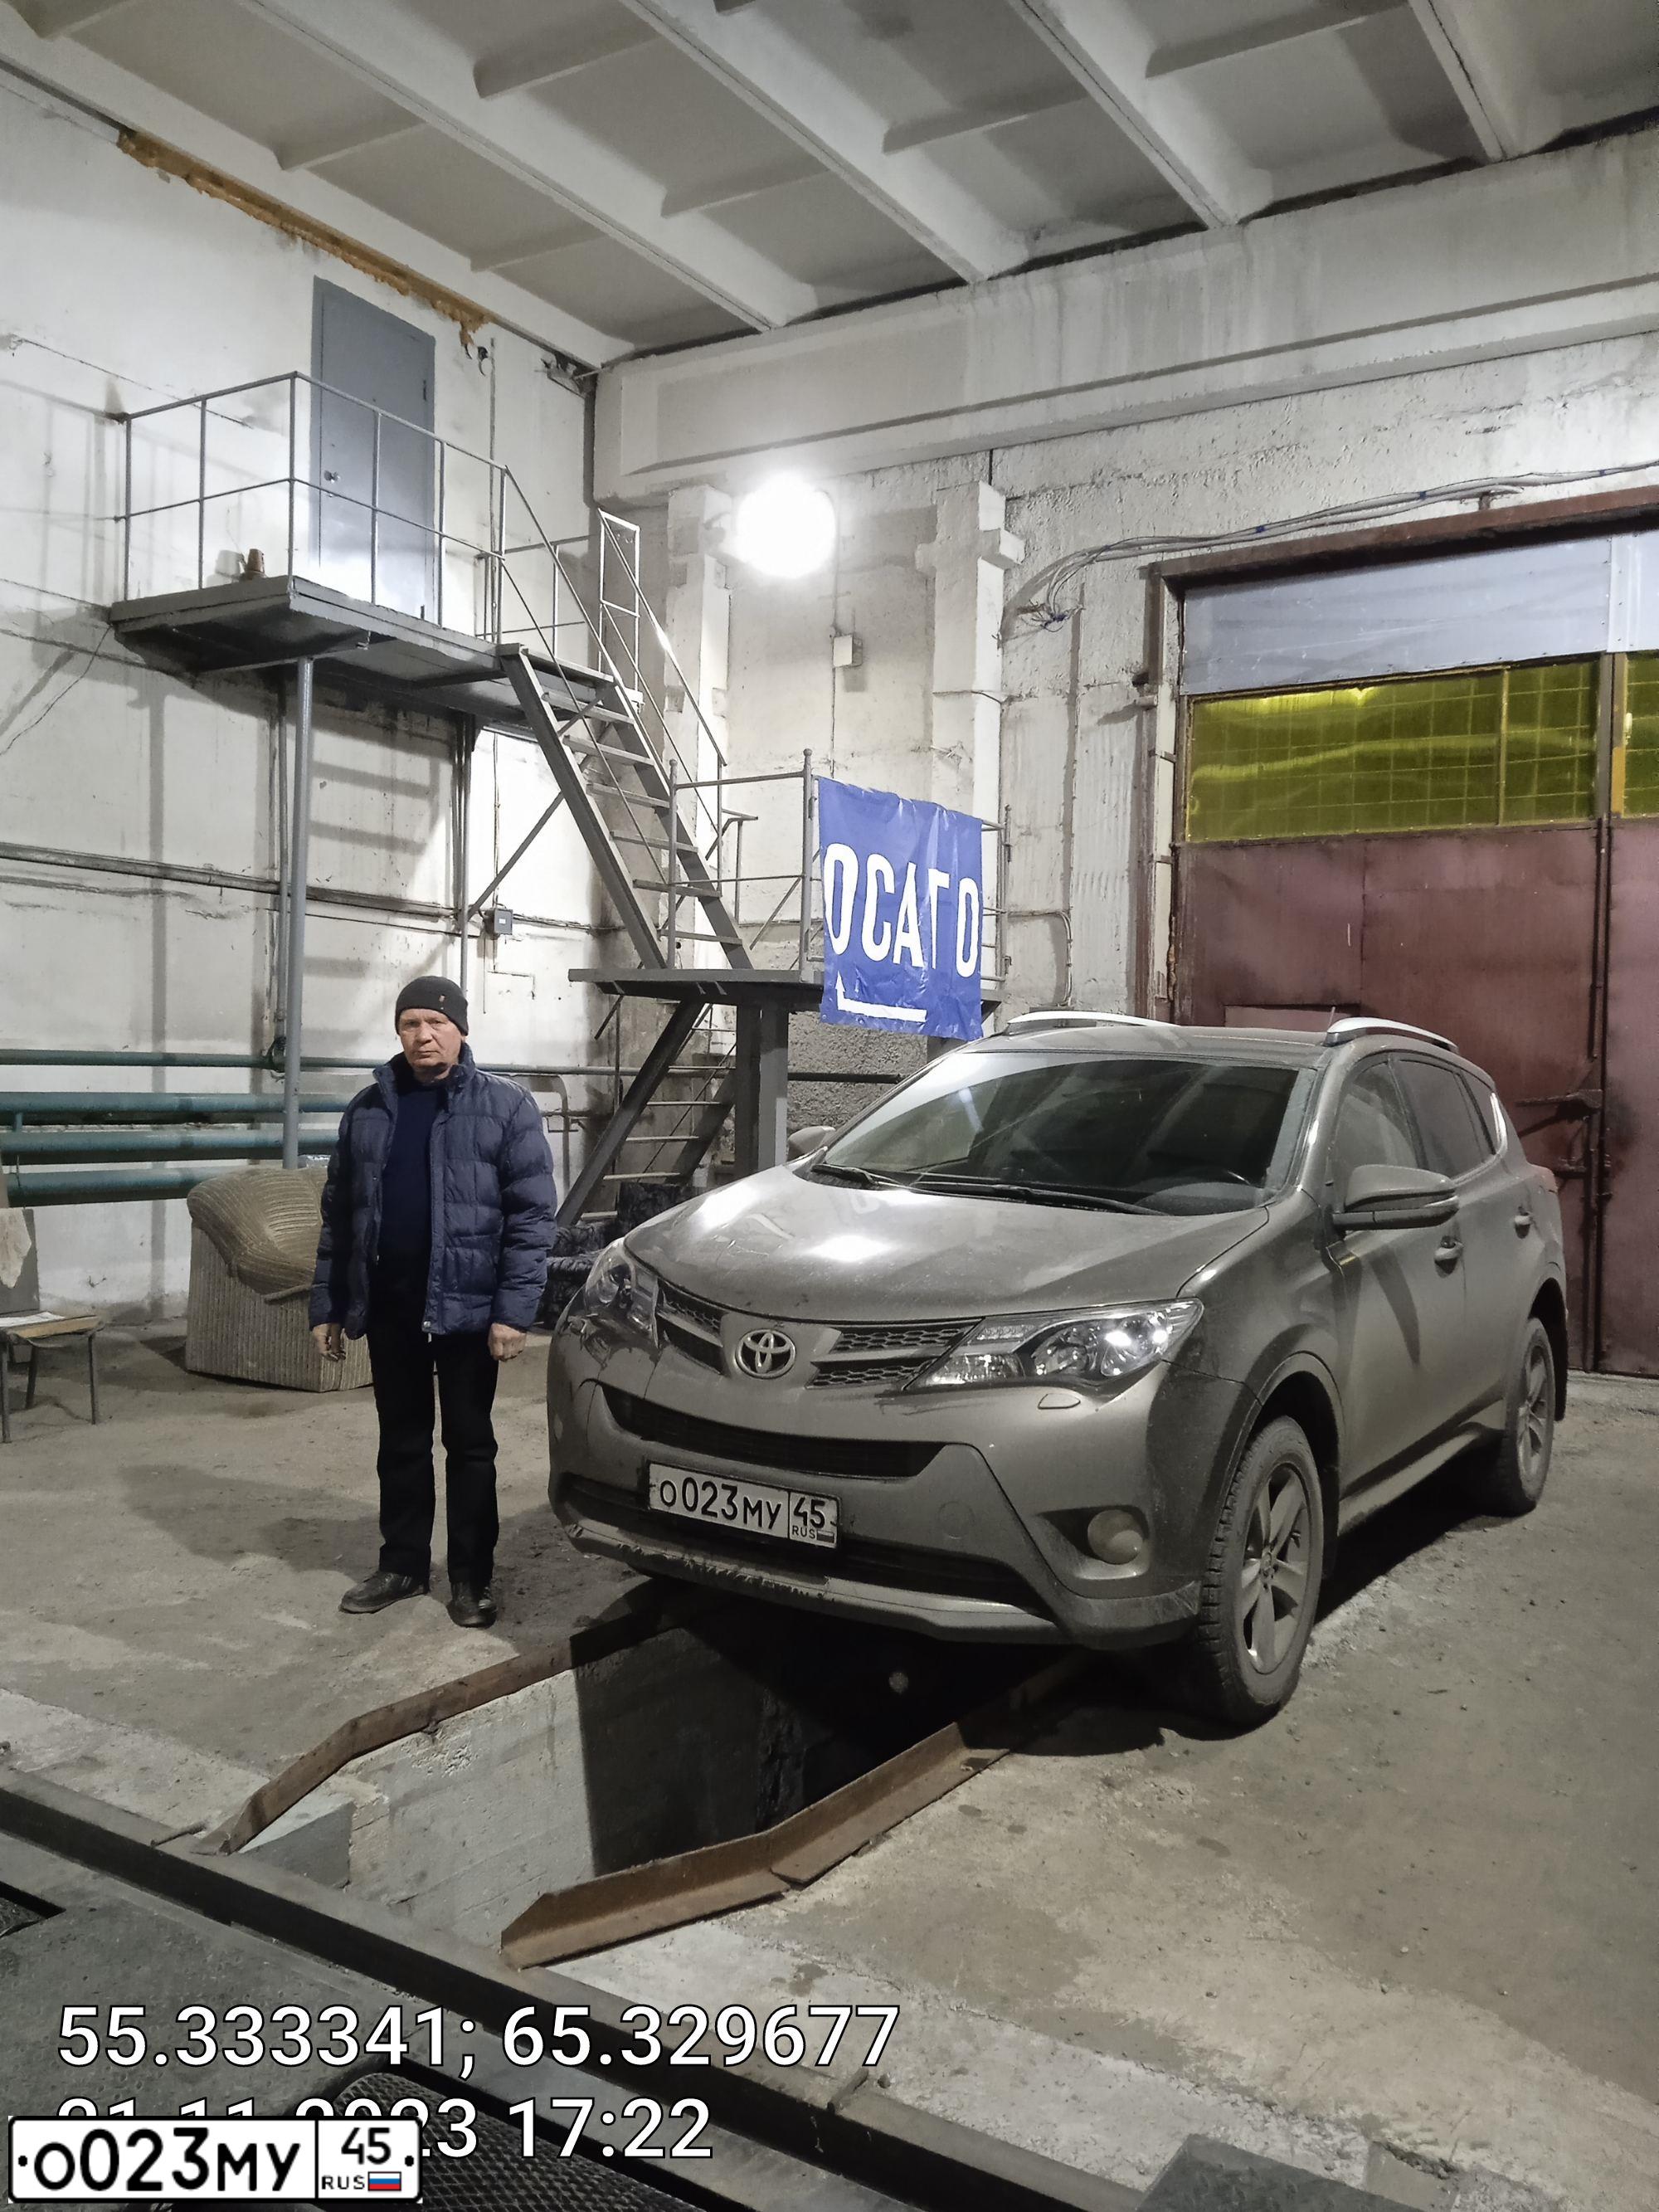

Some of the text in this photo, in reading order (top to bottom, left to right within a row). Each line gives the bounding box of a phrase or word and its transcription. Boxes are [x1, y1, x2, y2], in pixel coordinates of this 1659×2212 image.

[824, 843, 980, 978] ОСАГО
[793, 1497, 825, 1529] 45
[791, 1525, 815, 1539] RUS
